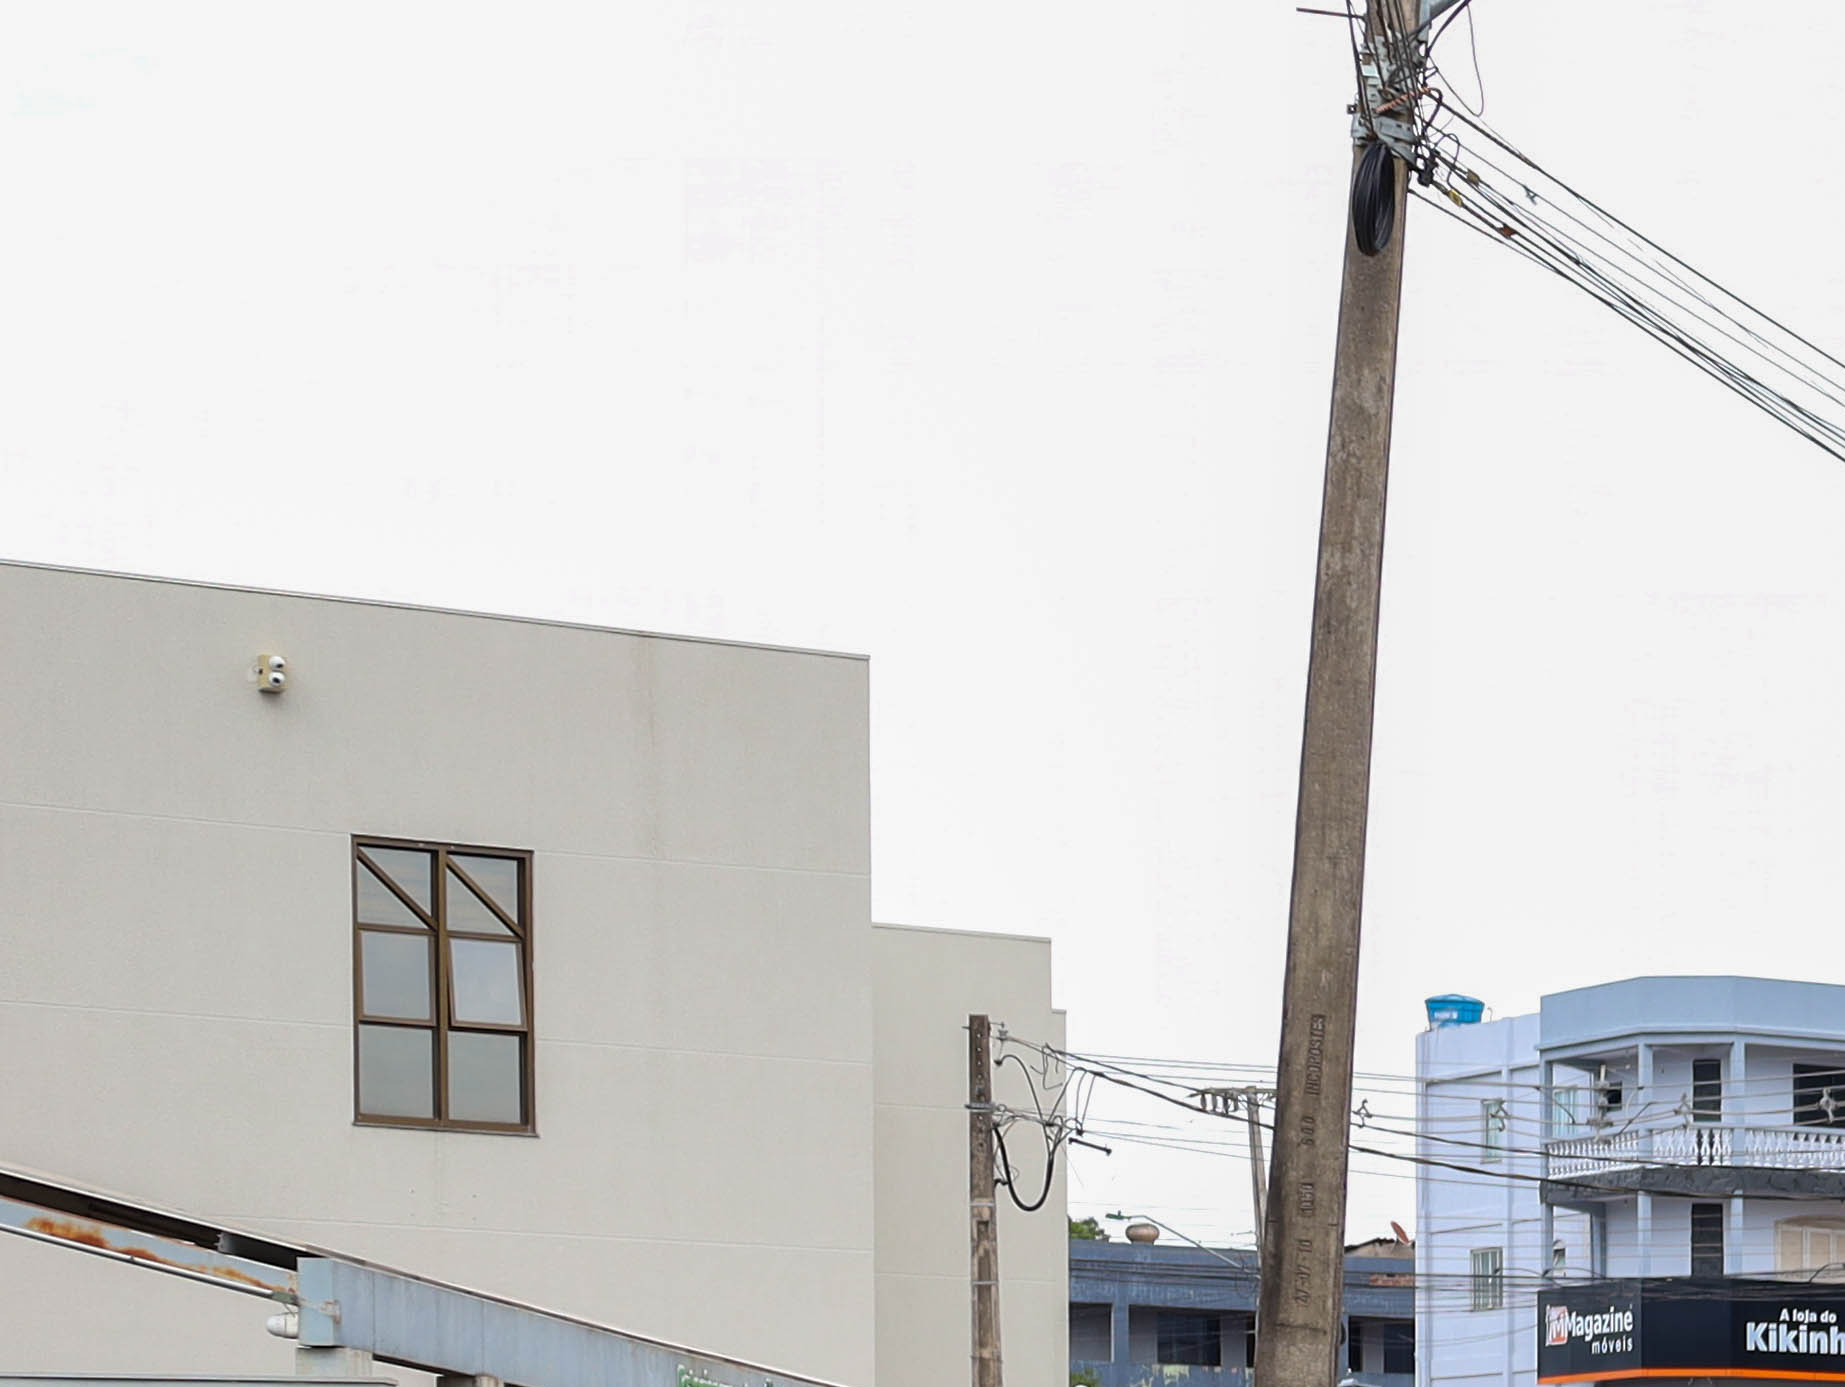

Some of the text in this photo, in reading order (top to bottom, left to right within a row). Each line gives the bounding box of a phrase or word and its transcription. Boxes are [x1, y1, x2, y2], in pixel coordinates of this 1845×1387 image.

[1780, 1309, 1838, 1324] A loja do
[1591, 1336, 1634, 1355] móveis
